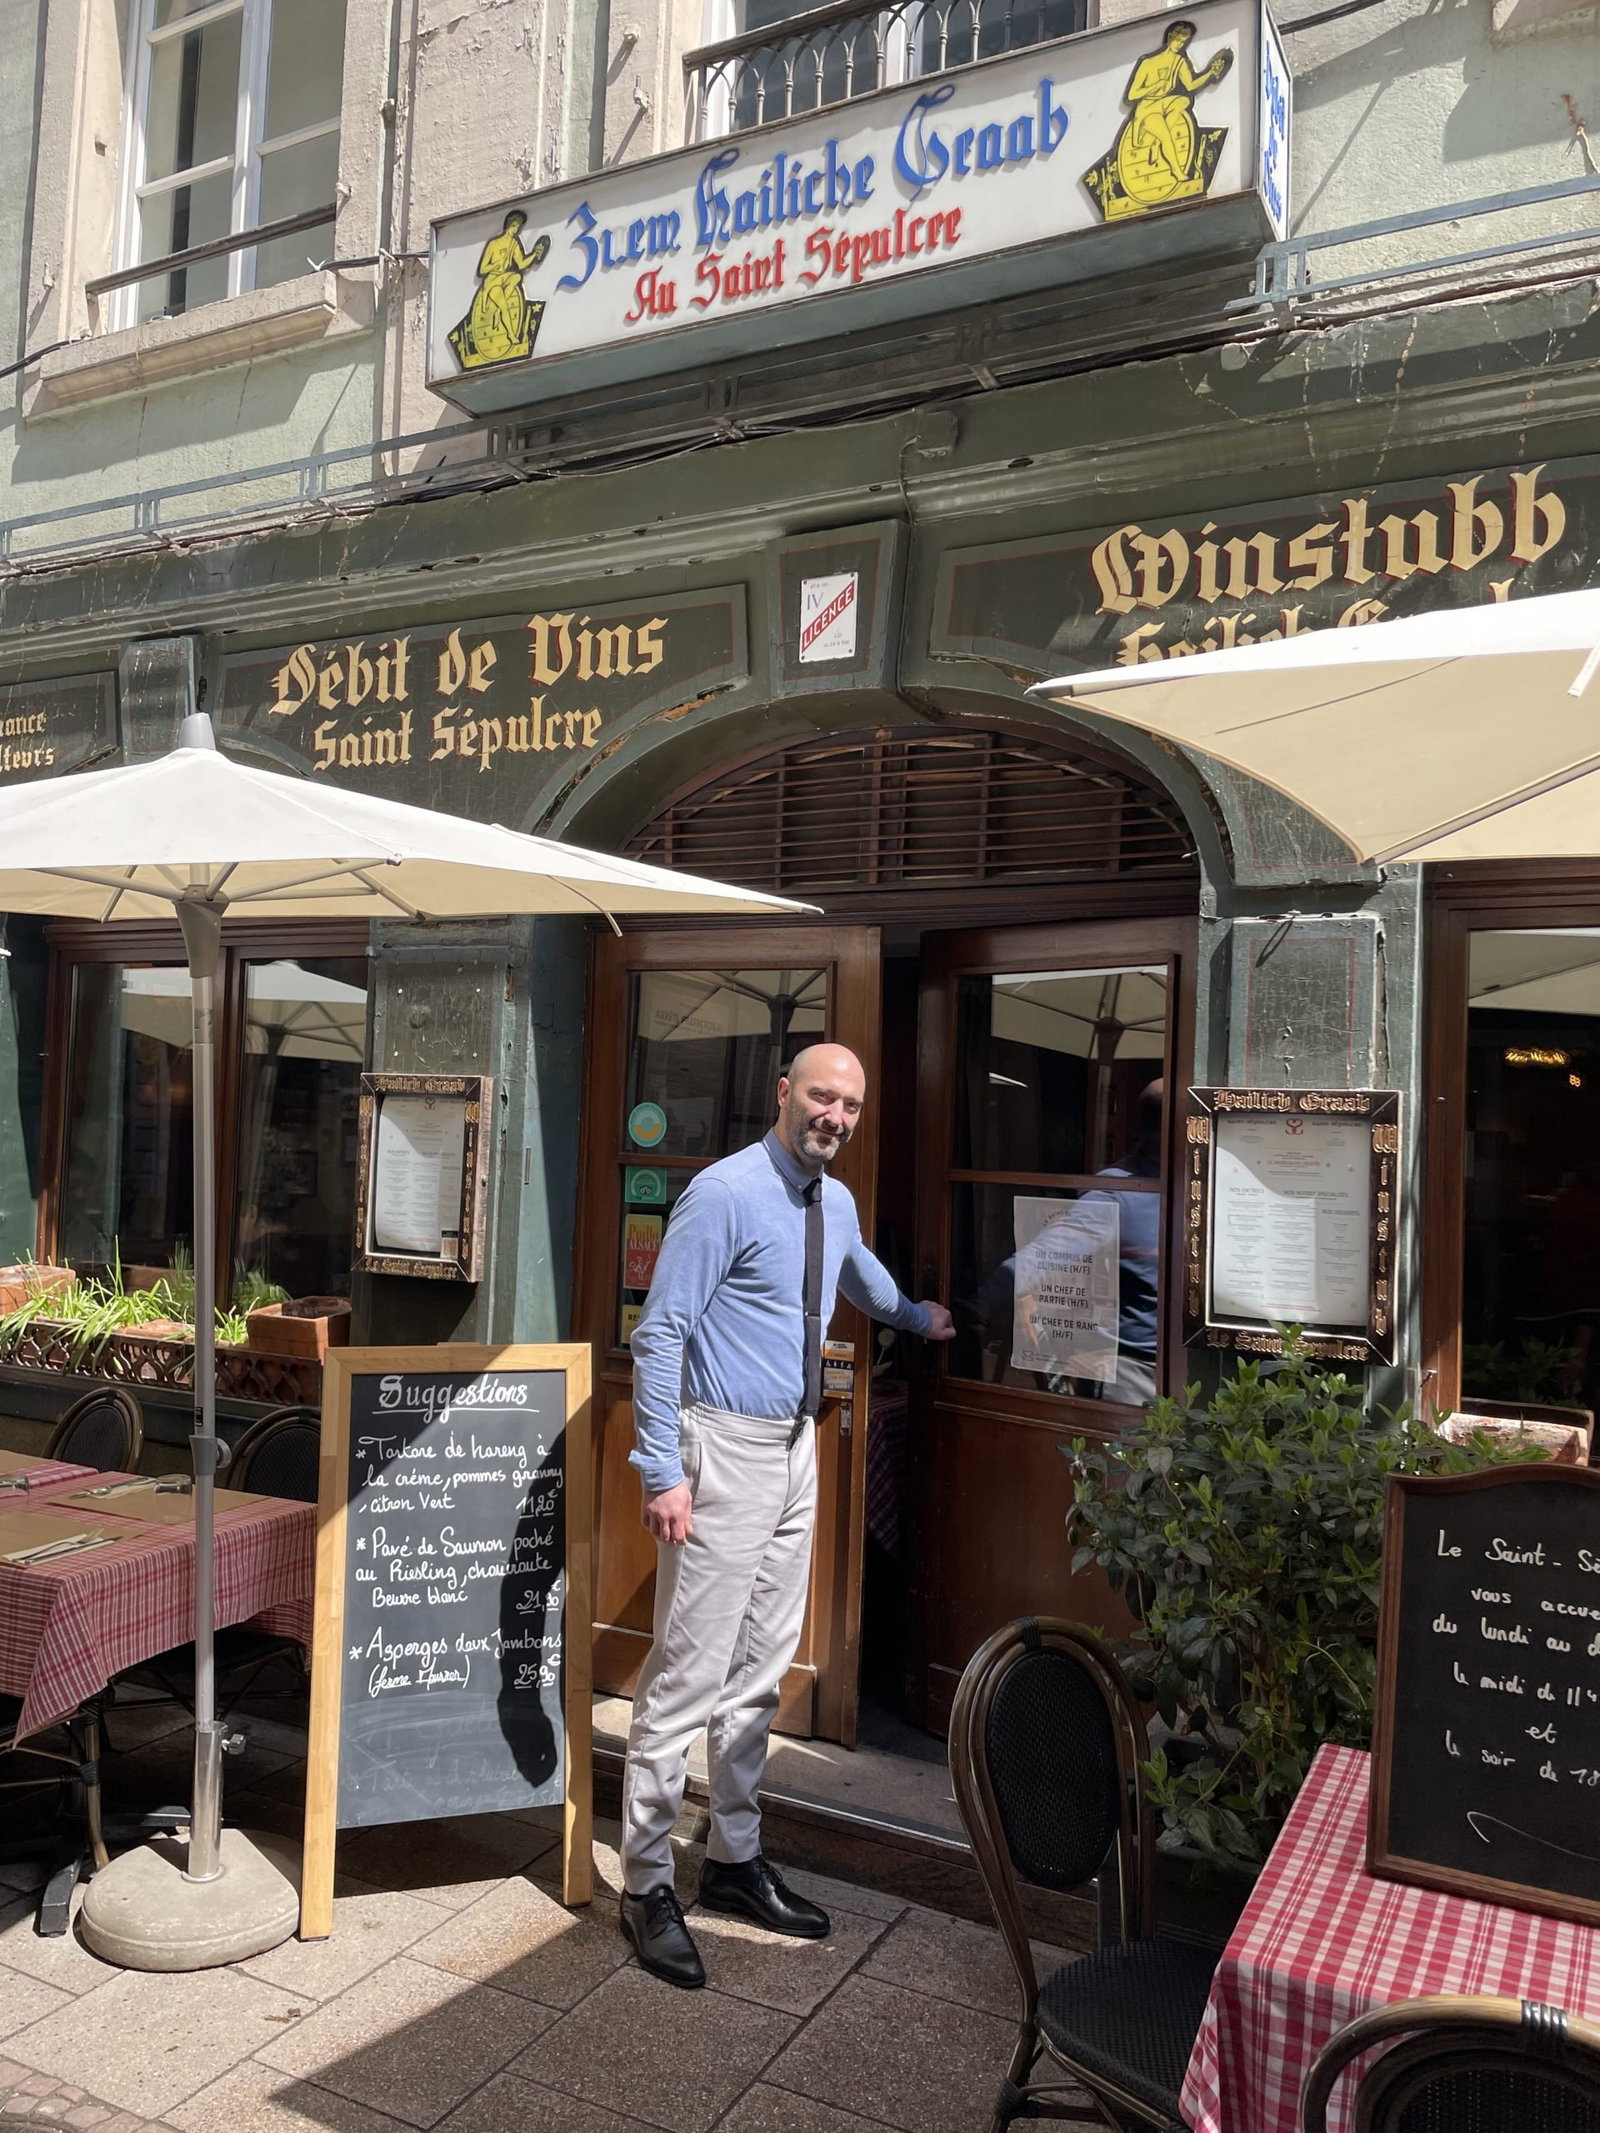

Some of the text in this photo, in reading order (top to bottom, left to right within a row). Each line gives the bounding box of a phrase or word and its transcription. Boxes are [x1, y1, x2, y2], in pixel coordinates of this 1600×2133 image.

[625, 266, 677, 321] Au
[690, 238, 786, 307] Saint
[1091, 463, 1566, 614] Winstubb
[807, 592, 824, 610] IV
[803, 585, 853, 648] LICENCE
[268, 613, 669, 716] Débit de Vins
[313, 694, 602, 773] Saint Sépulcre
[1048, 1251, 1080, 1262] COMMIS
[1082, 1254, 1094, 1264] DE
[1069, 1264, 1091, 1275] (H/F)
[1039, 1294, 1089, 1309] PARTIE (H/F)
[1041, 1283, 1087, 1297] UN CHEF DE
[1042, 1317, 1062, 1327] CHEF
[1064, 1320, 1075, 1329] DE
[1052, 1331, 1073, 1341] (H/F)
[378, 1374, 528, 1423] Suggestions
[358, 1431, 551, 1469] Tartare de hareng à
[362, 1464, 389, 1487] la
[453, 1471, 507, 1488] pommes
[512, 1466, 563, 1489] granny
[419, 1491, 456, 1510] Vert
[372, 1526, 554, 1561] Pavé de Saumon poché
[1437, 1529, 1462, 1557] Le
[356, 1567, 378, 1582] au
[427, 1585, 468, 1605] blanc
[1470, 1587, 1512, 1604] vous
[1432, 1613, 1458, 1634] du
[1480, 1616, 1532, 1645] lundi
[1546, 1636, 1571, 1652] au
[366, 1626, 562, 1670] Asperges deux Jambons
[1453, 1661, 1469, 1686] le
[1480, 1674, 1526, 1695] midi
[1537, 1682, 1556, 1701] de
[1524, 1722, 1558, 1744] et
[1445, 1729, 1461, 1756] le
[1481, 1749, 1516, 1766] soir
[1539, 1760, 1559, 1783] de
